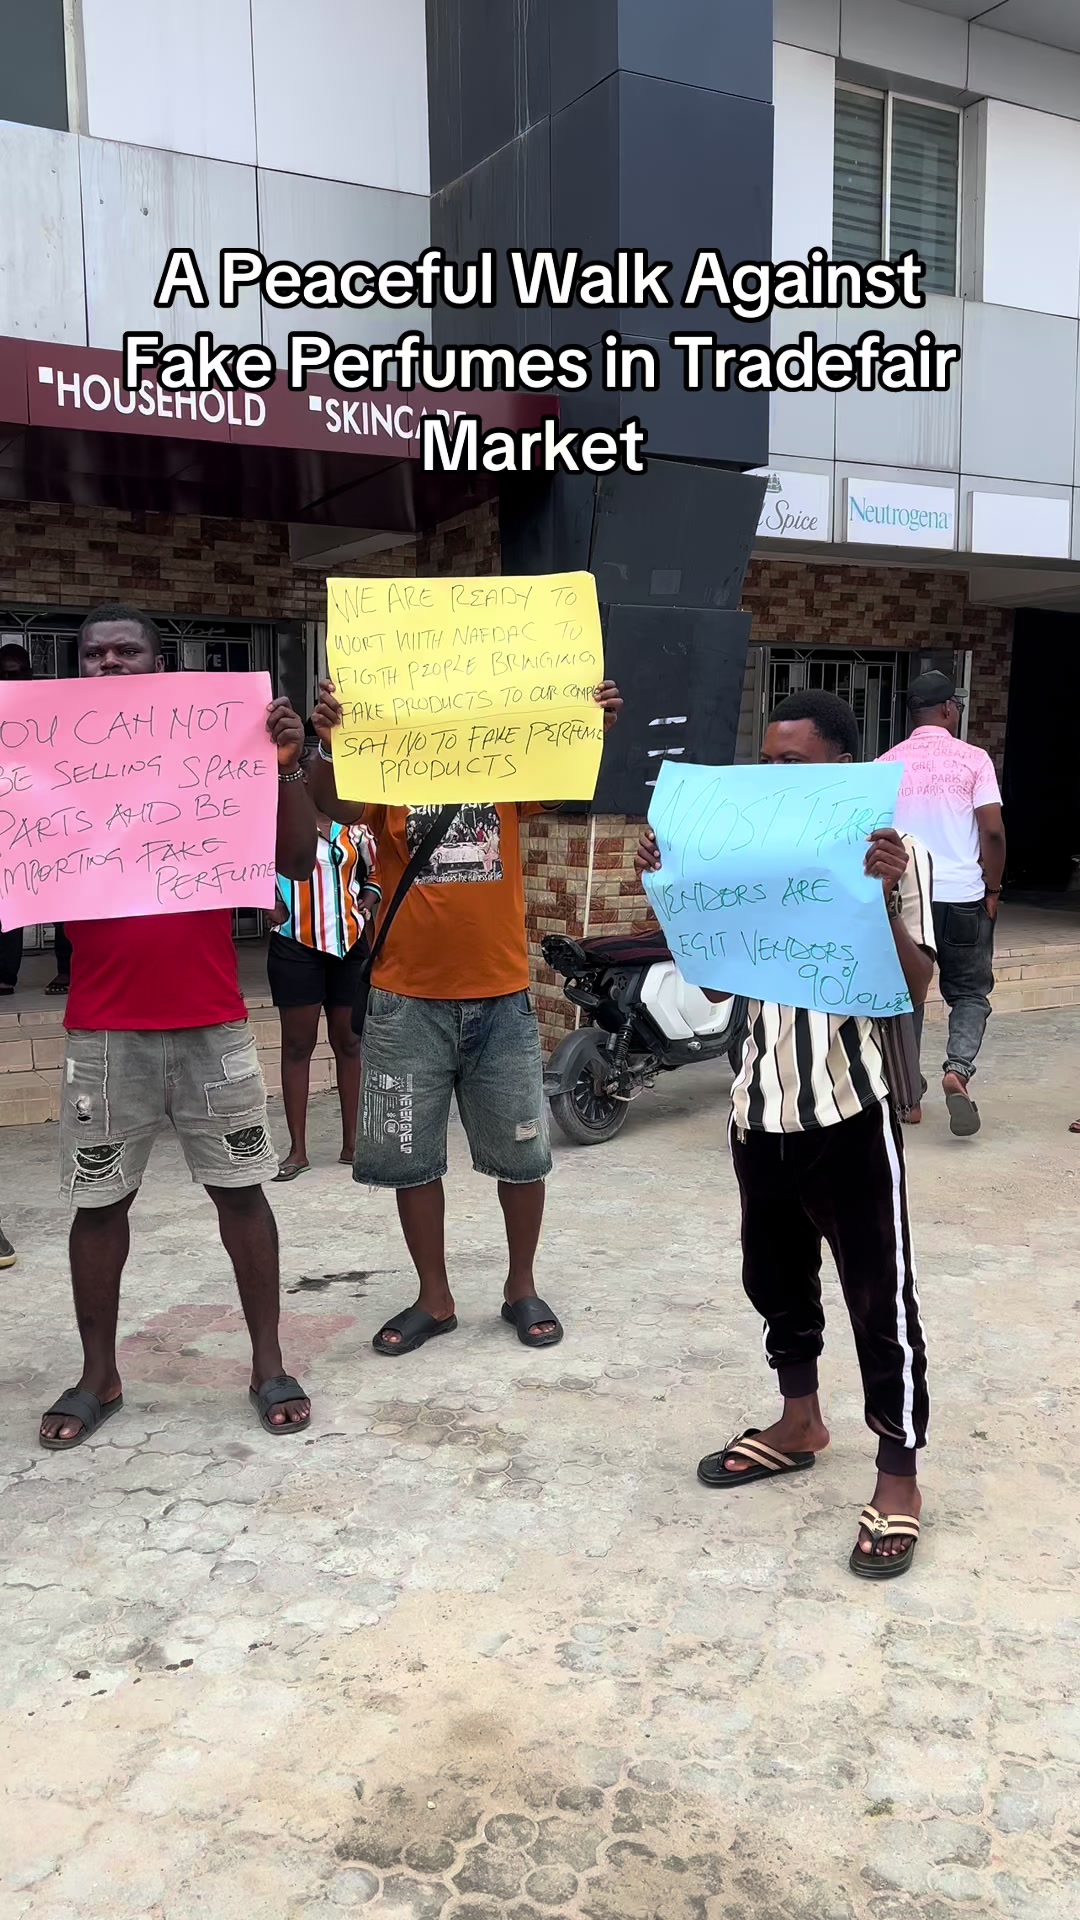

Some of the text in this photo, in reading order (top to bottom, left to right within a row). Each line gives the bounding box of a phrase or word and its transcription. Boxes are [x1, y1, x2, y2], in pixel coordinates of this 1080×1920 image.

[56, 370, 468, 440] HOUSEHOLD SKINCA
[765, 500, 818, 534] Spice
[849, 496, 949, 532] Neutrogena
[331, 583, 577, 623] WE ARE READY TO
[452, 621, 537, 647] NAFDAC
[554, 620, 583, 641] TO
[336, 666, 400, 693] FIGTH
[408, 654, 478, 690] PEOPLE
[0, 714, 57, 748] OU
[170, 701, 244, 739] NOT
[339, 701, 385, 728] FAKE
[392, 690, 493, 725] PRODUCTS
[501, 686, 523, 707] TO
[529, 685, 560, 702] OUR
[340, 734, 388, 758] SAY
[396, 731, 427, 757] NO
[431, 728, 458, 755] TO
[468, 725, 521, 752] FAKE
[51, 755, 162, 790] SELLING
[178, 754, 268, 788] SPARE
[380, 754, 518, 793] PRODUCTS
[195, 793, 241, 821] BE
[655, 777, 801, 878] MOST
[0, 837, 228, 899] MPORTING FAKE
[156, 861, 277, 904] PERFUME
[652, 874, 834, 921] VENDORS ARE
[740, 928, 856, 965] VENDORS
[399, 1094, 413, 1122] NEVER
[400, 1143, 413, 1154] UP
